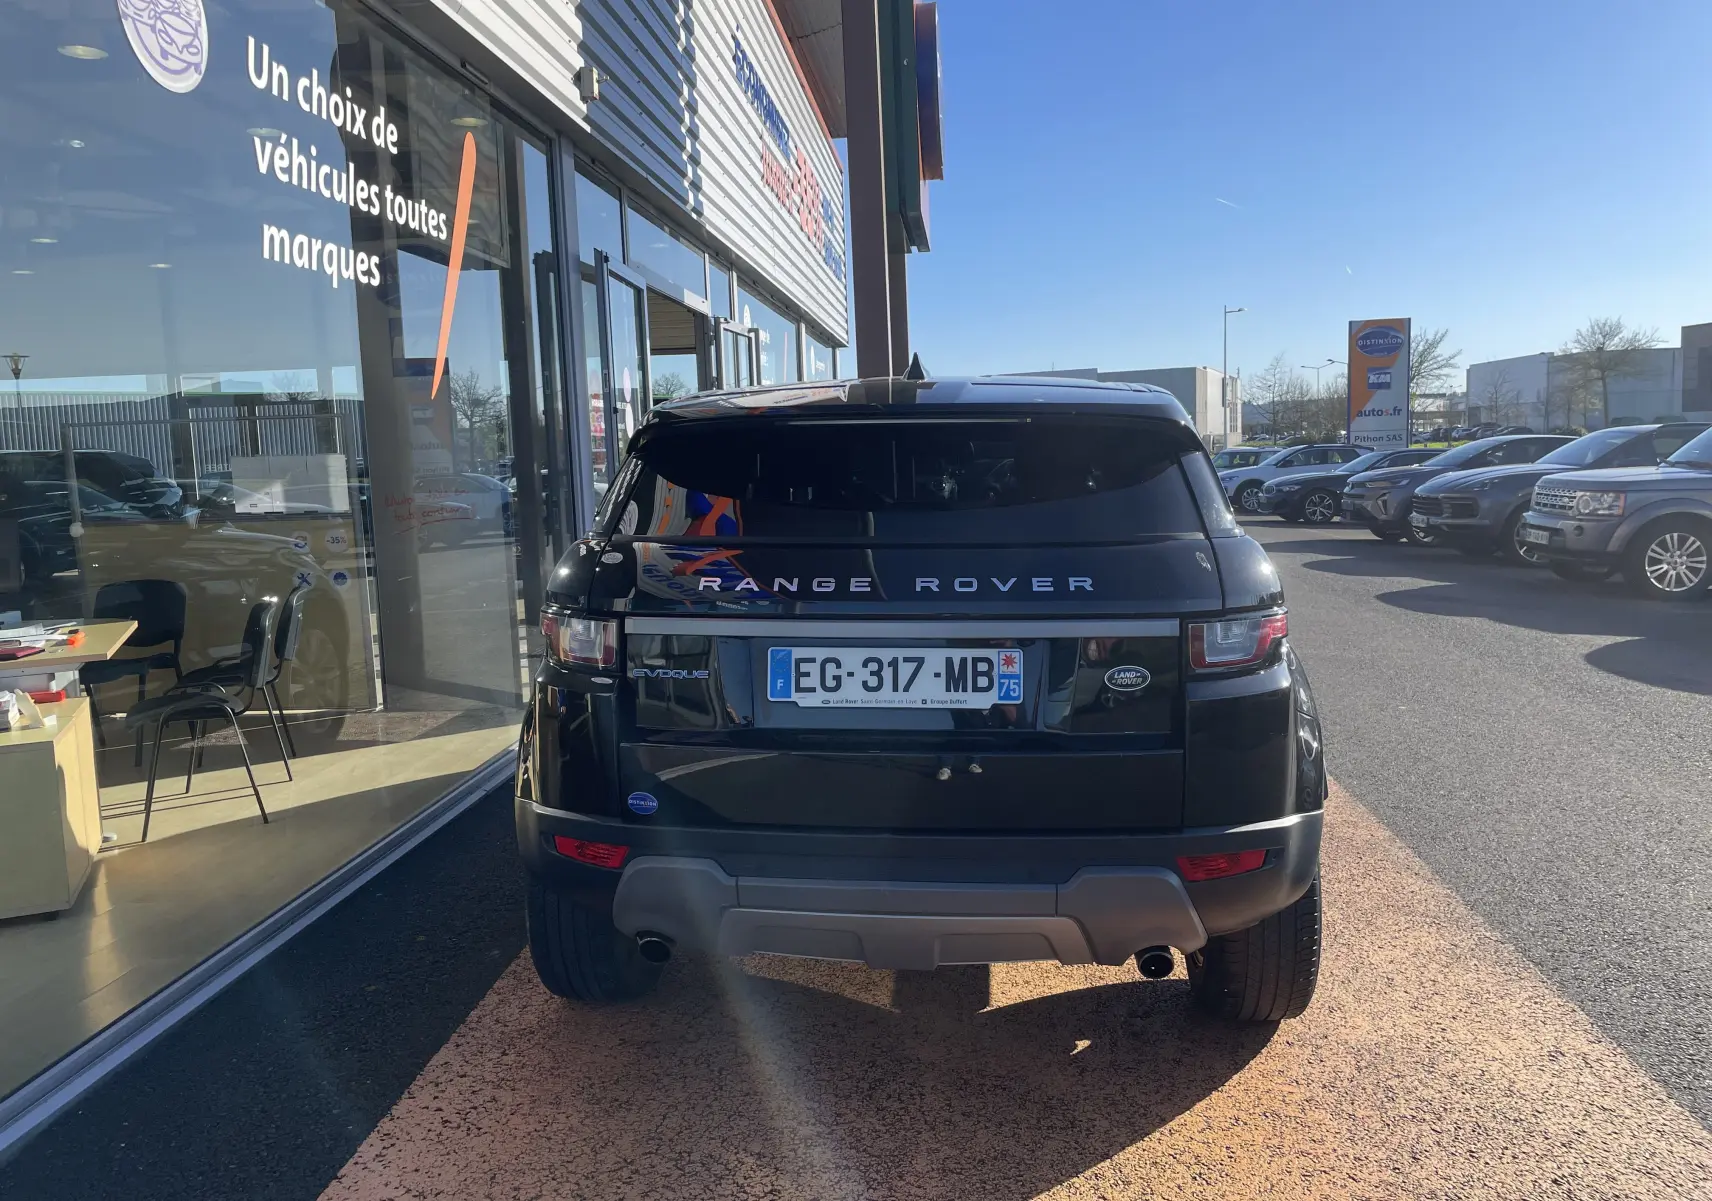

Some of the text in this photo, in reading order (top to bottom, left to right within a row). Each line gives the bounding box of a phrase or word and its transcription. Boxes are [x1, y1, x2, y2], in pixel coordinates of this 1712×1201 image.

[247, 35, 399, 155] Un choix de
[253, 131, 448, 241] véhicules toutes
[262, 223, 381, 289] marques
[1357, 337, 1403, 346] DISTINXION
[1356, 405, 1403, 418] autos.fr
[1354, 433, 1403, 443] Pithon SAS
[326, 536, 347, 544] -35%
[698, 576, 1094, 592] RANGE ROVER
[632, 668, 709, 679] EVOQUE
[794, 656, 995, 694] EG-317-MB
[1114, 671, 1136, 679] LAND
[777, 679, 784, 690] F
[1116, 677, 1143, 685] ROVER
[999, 679, 1020, 697] 75
